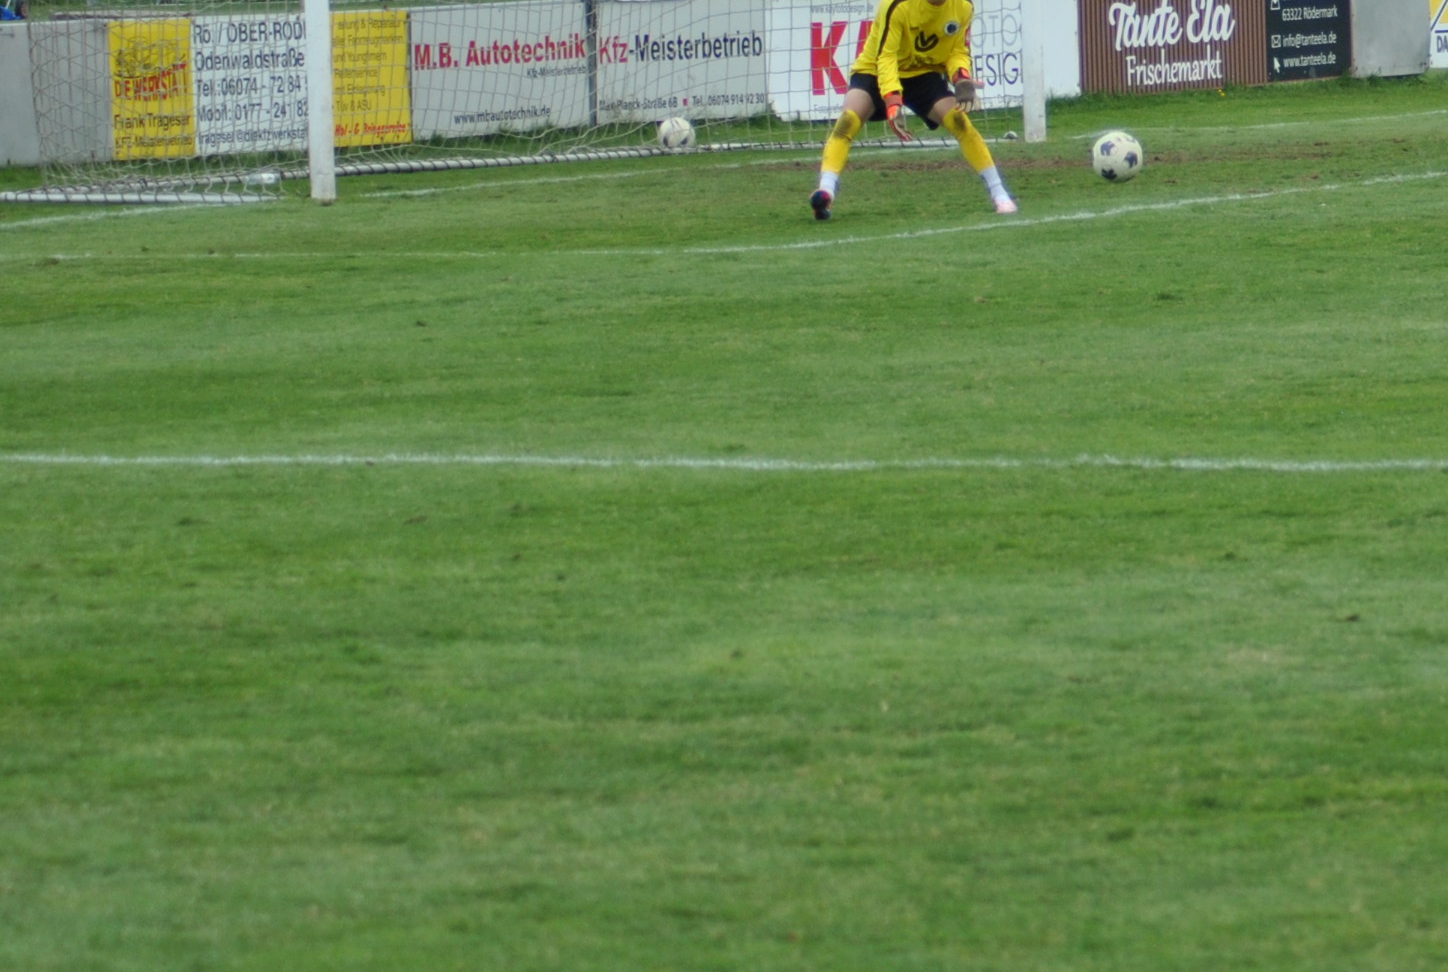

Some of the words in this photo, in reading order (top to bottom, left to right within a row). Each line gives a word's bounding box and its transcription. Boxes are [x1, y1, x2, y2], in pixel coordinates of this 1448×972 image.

[1282, 6, 1302, 21] 63322
[1303, 5, 1338, 19] Rödermark
[971, 14, 1018, 48] OTO
[1282, 32, 1337, 49] info@tanteela.de
[414, 40, 459, 71] M.B.
[465, 31, 587, 68] Autotechnik
[599, 30, 764, 65] Kfz-Meisterbetrieb
[195, 48, 305, 71] Odenwaldstraße
[974, 53, 1024, 87] ESIG
[1126, 44, 1223, 87] Frischemarkt
[1283, 52, 1336, 68] www.tanteela.de
[114, 78, 132, 101] DE
[114, 113, 145, 129] Frank
[146, 112, 191, 131] Trageser
[454, 104, 551, 125] www.mbautotechnik.de
